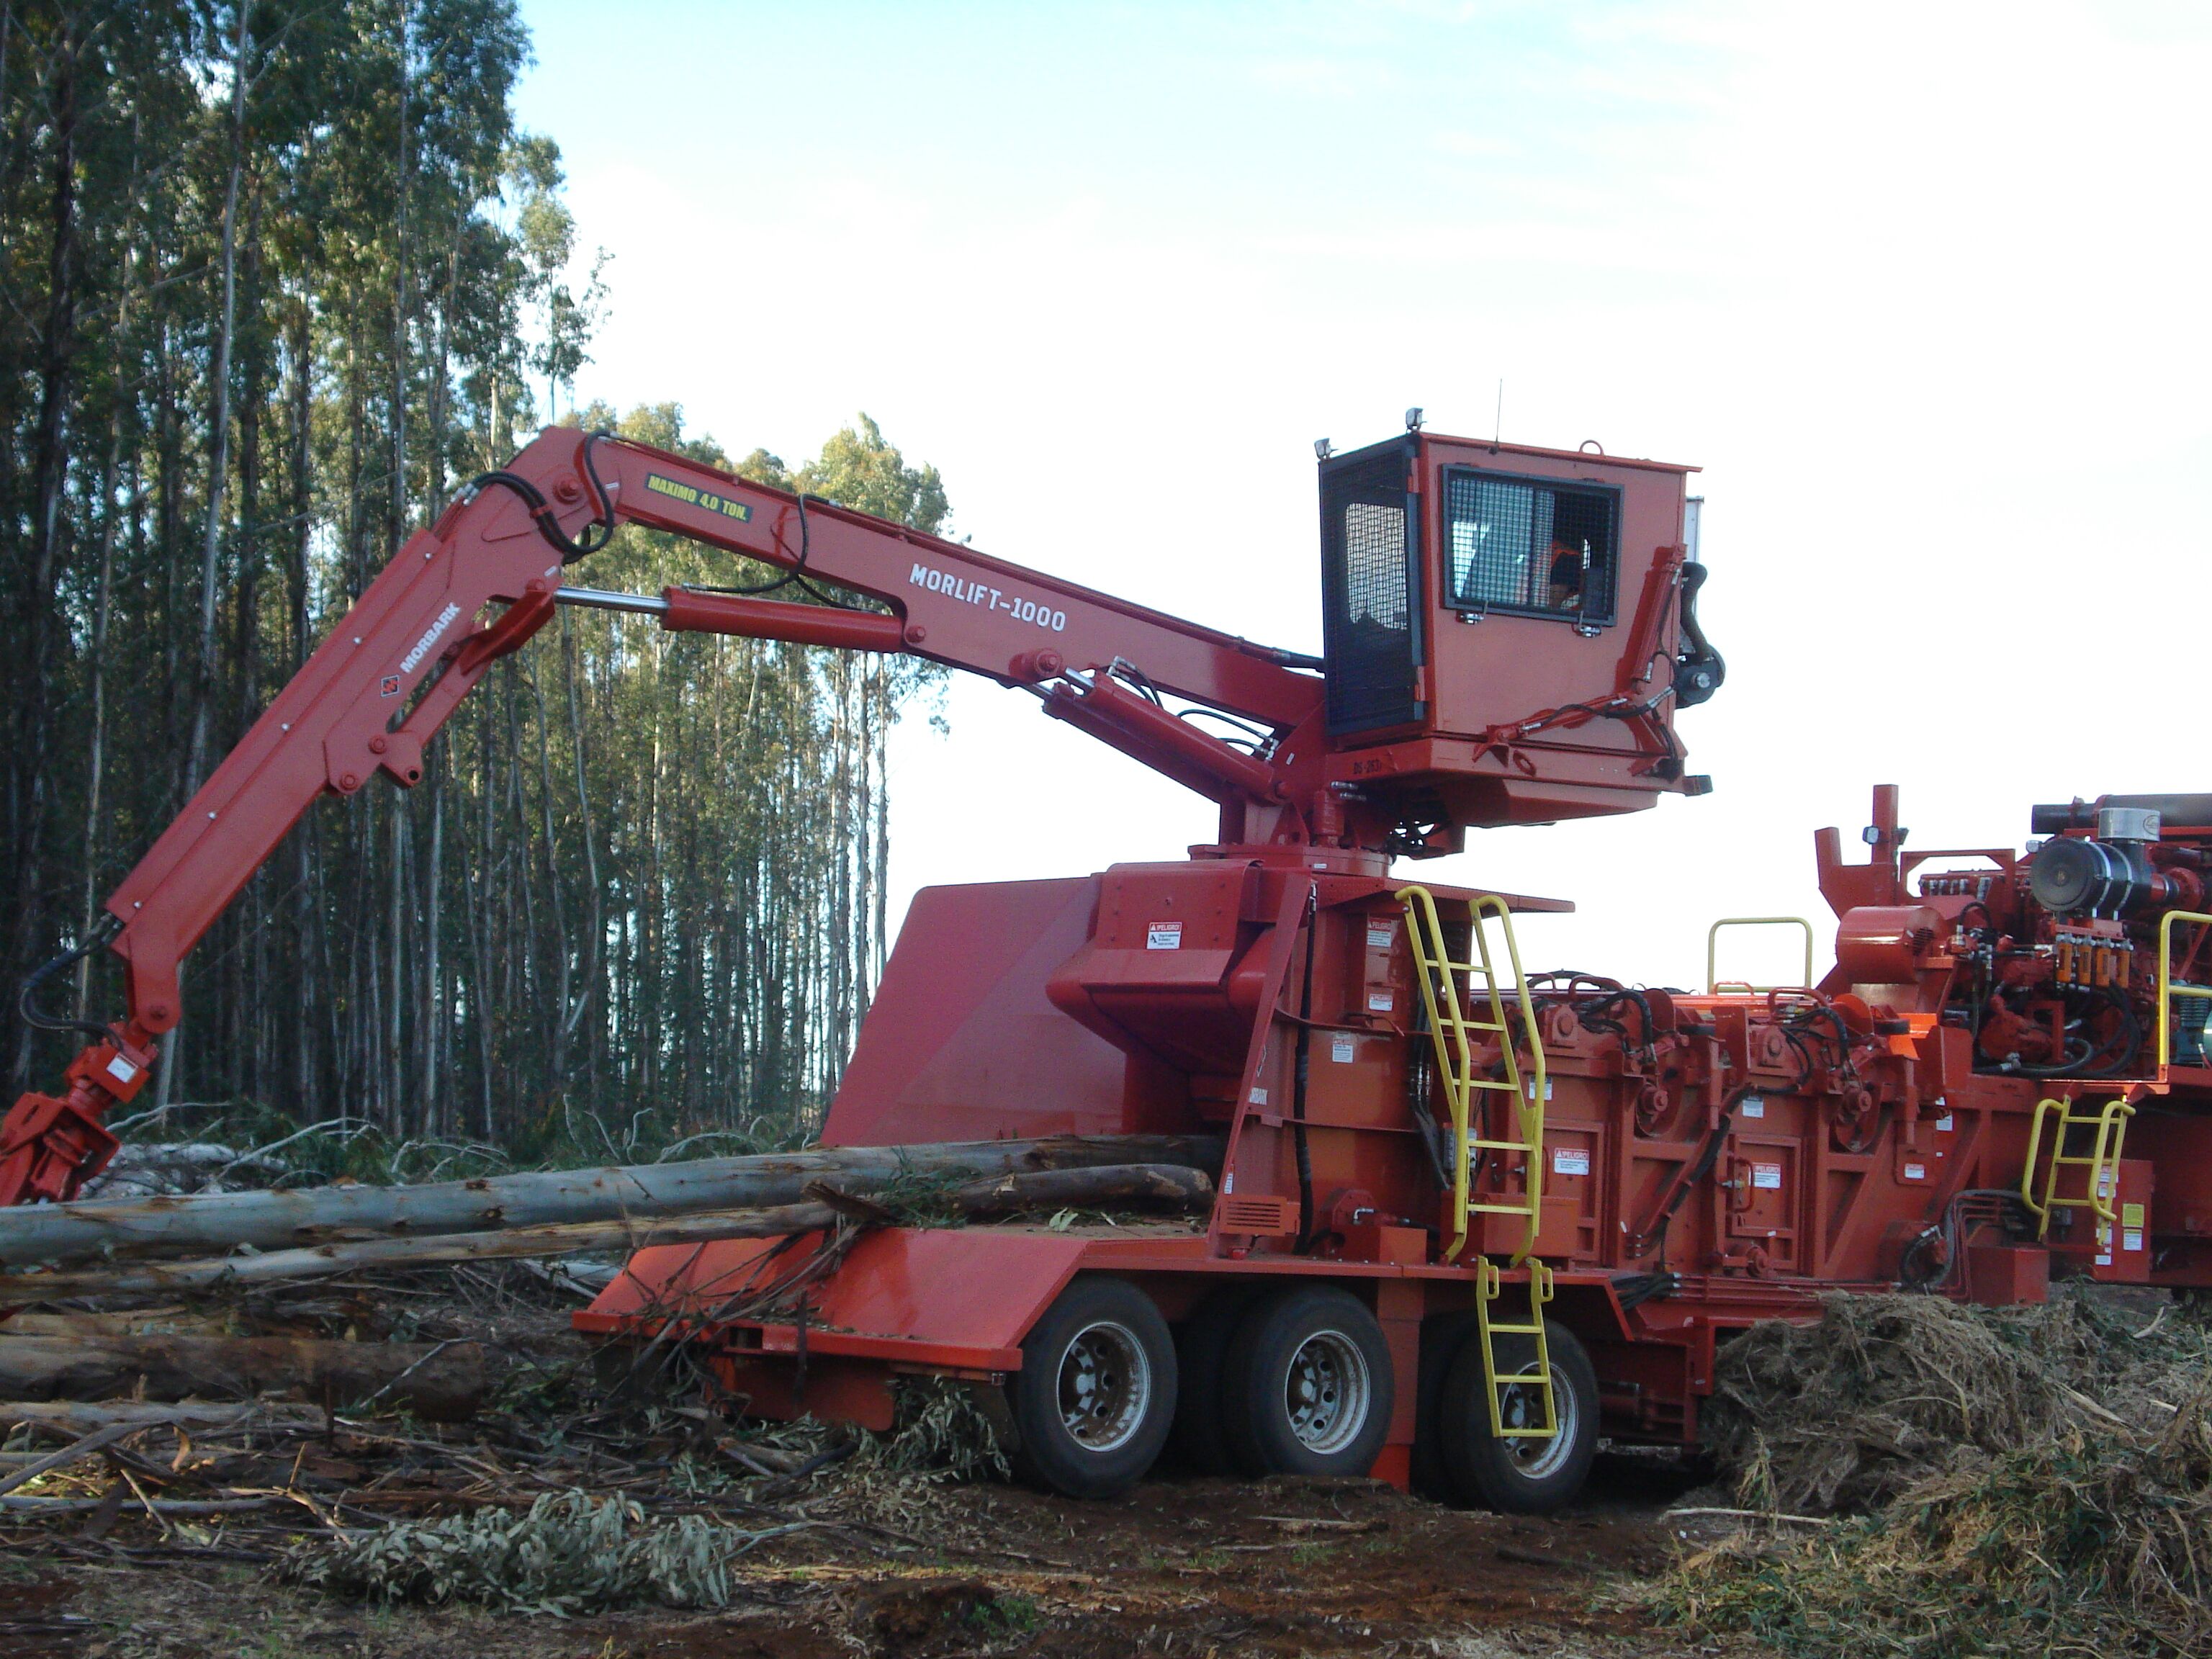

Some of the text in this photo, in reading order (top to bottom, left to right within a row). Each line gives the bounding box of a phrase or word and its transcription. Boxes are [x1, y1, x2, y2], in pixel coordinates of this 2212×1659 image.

[648, 475, 697, 503] MAXIMO
[909, 563, 1066, 632] MORLIFT-1000
[400, 602, 461, 673] MORBARK
